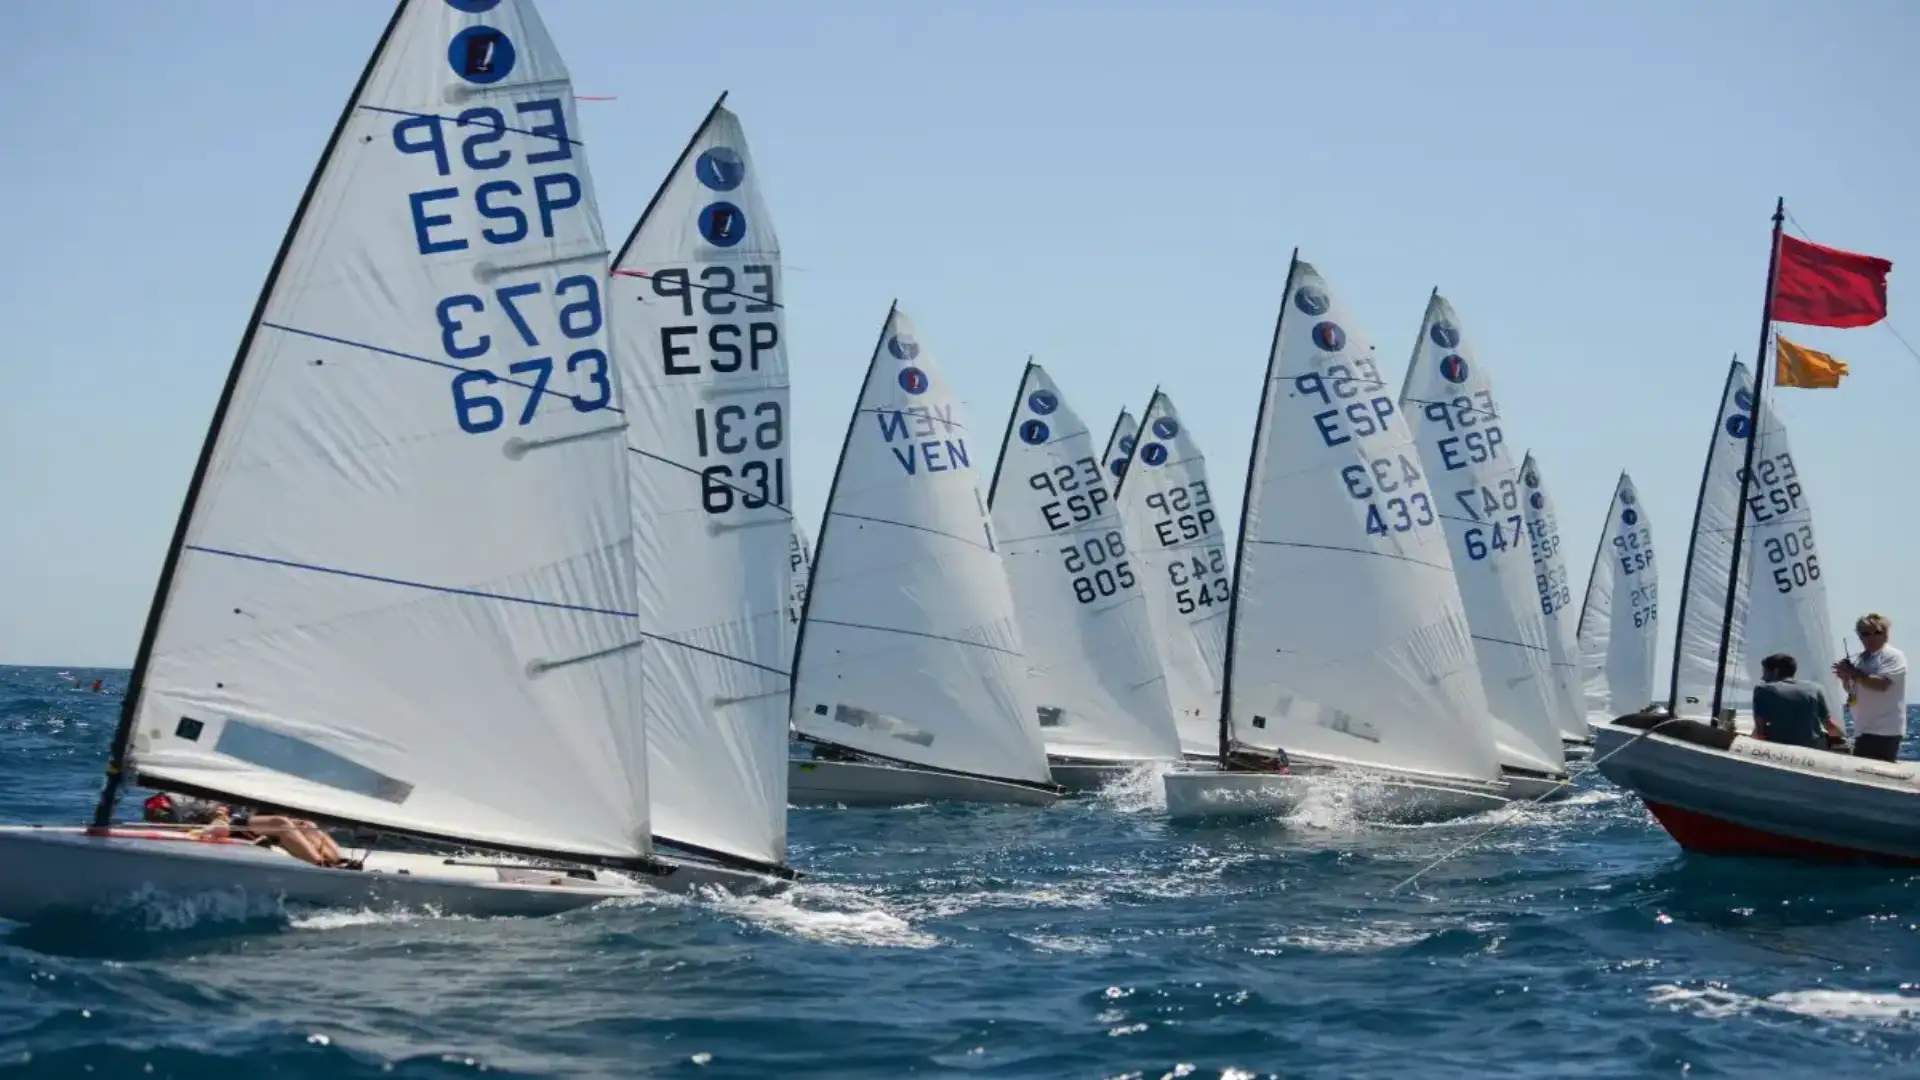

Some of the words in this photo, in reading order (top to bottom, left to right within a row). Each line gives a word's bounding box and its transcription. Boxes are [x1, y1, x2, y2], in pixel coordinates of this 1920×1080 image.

[408, 172, 582, 255] ESP
[660, 321, 778, 376] ESP
[450, 348, 612, 435] 673
[1313, 396, 1395, 447] ESP
[891, 439, 970, 476] VEN
[1437, 426, 1503, 471] ESP
[701, 457, 784, 514] 631
[1747, 482, 1801, 522] ESP
[1041, 487, 1108, 531] ESP
[1155, 508, 1215, 547] ESP
[1365, 492, 1434, 537] 433
[1464, 514, 1522, 560] 647
[1072, 561, 1135, 604] 805
[1621, 549, 1653, 575] ESP
[1773, 555, 1820, 594] 506
[1176, 578, 1230, 614] 543
